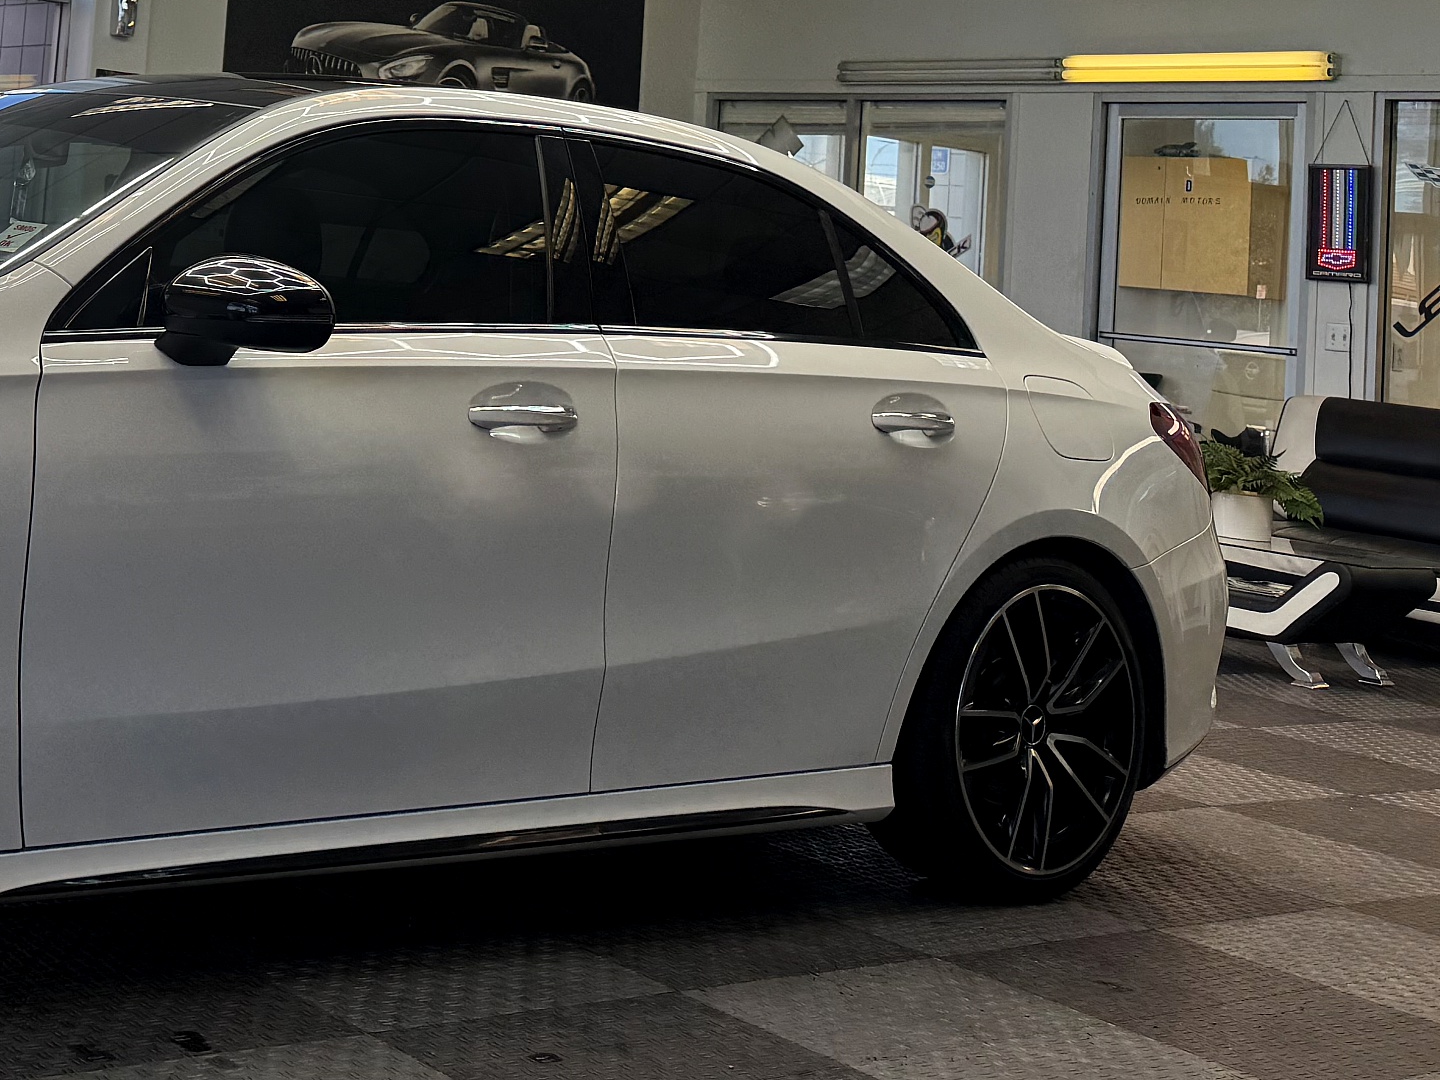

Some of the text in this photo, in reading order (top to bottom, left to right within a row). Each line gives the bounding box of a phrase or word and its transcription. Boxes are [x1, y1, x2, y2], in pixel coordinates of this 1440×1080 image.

[1135, 197, 1221, 205] DOMAIN MOTORS
[13, 224, 37, 232] SMOG
[1312, 270, 1362, 278] CAMARO
